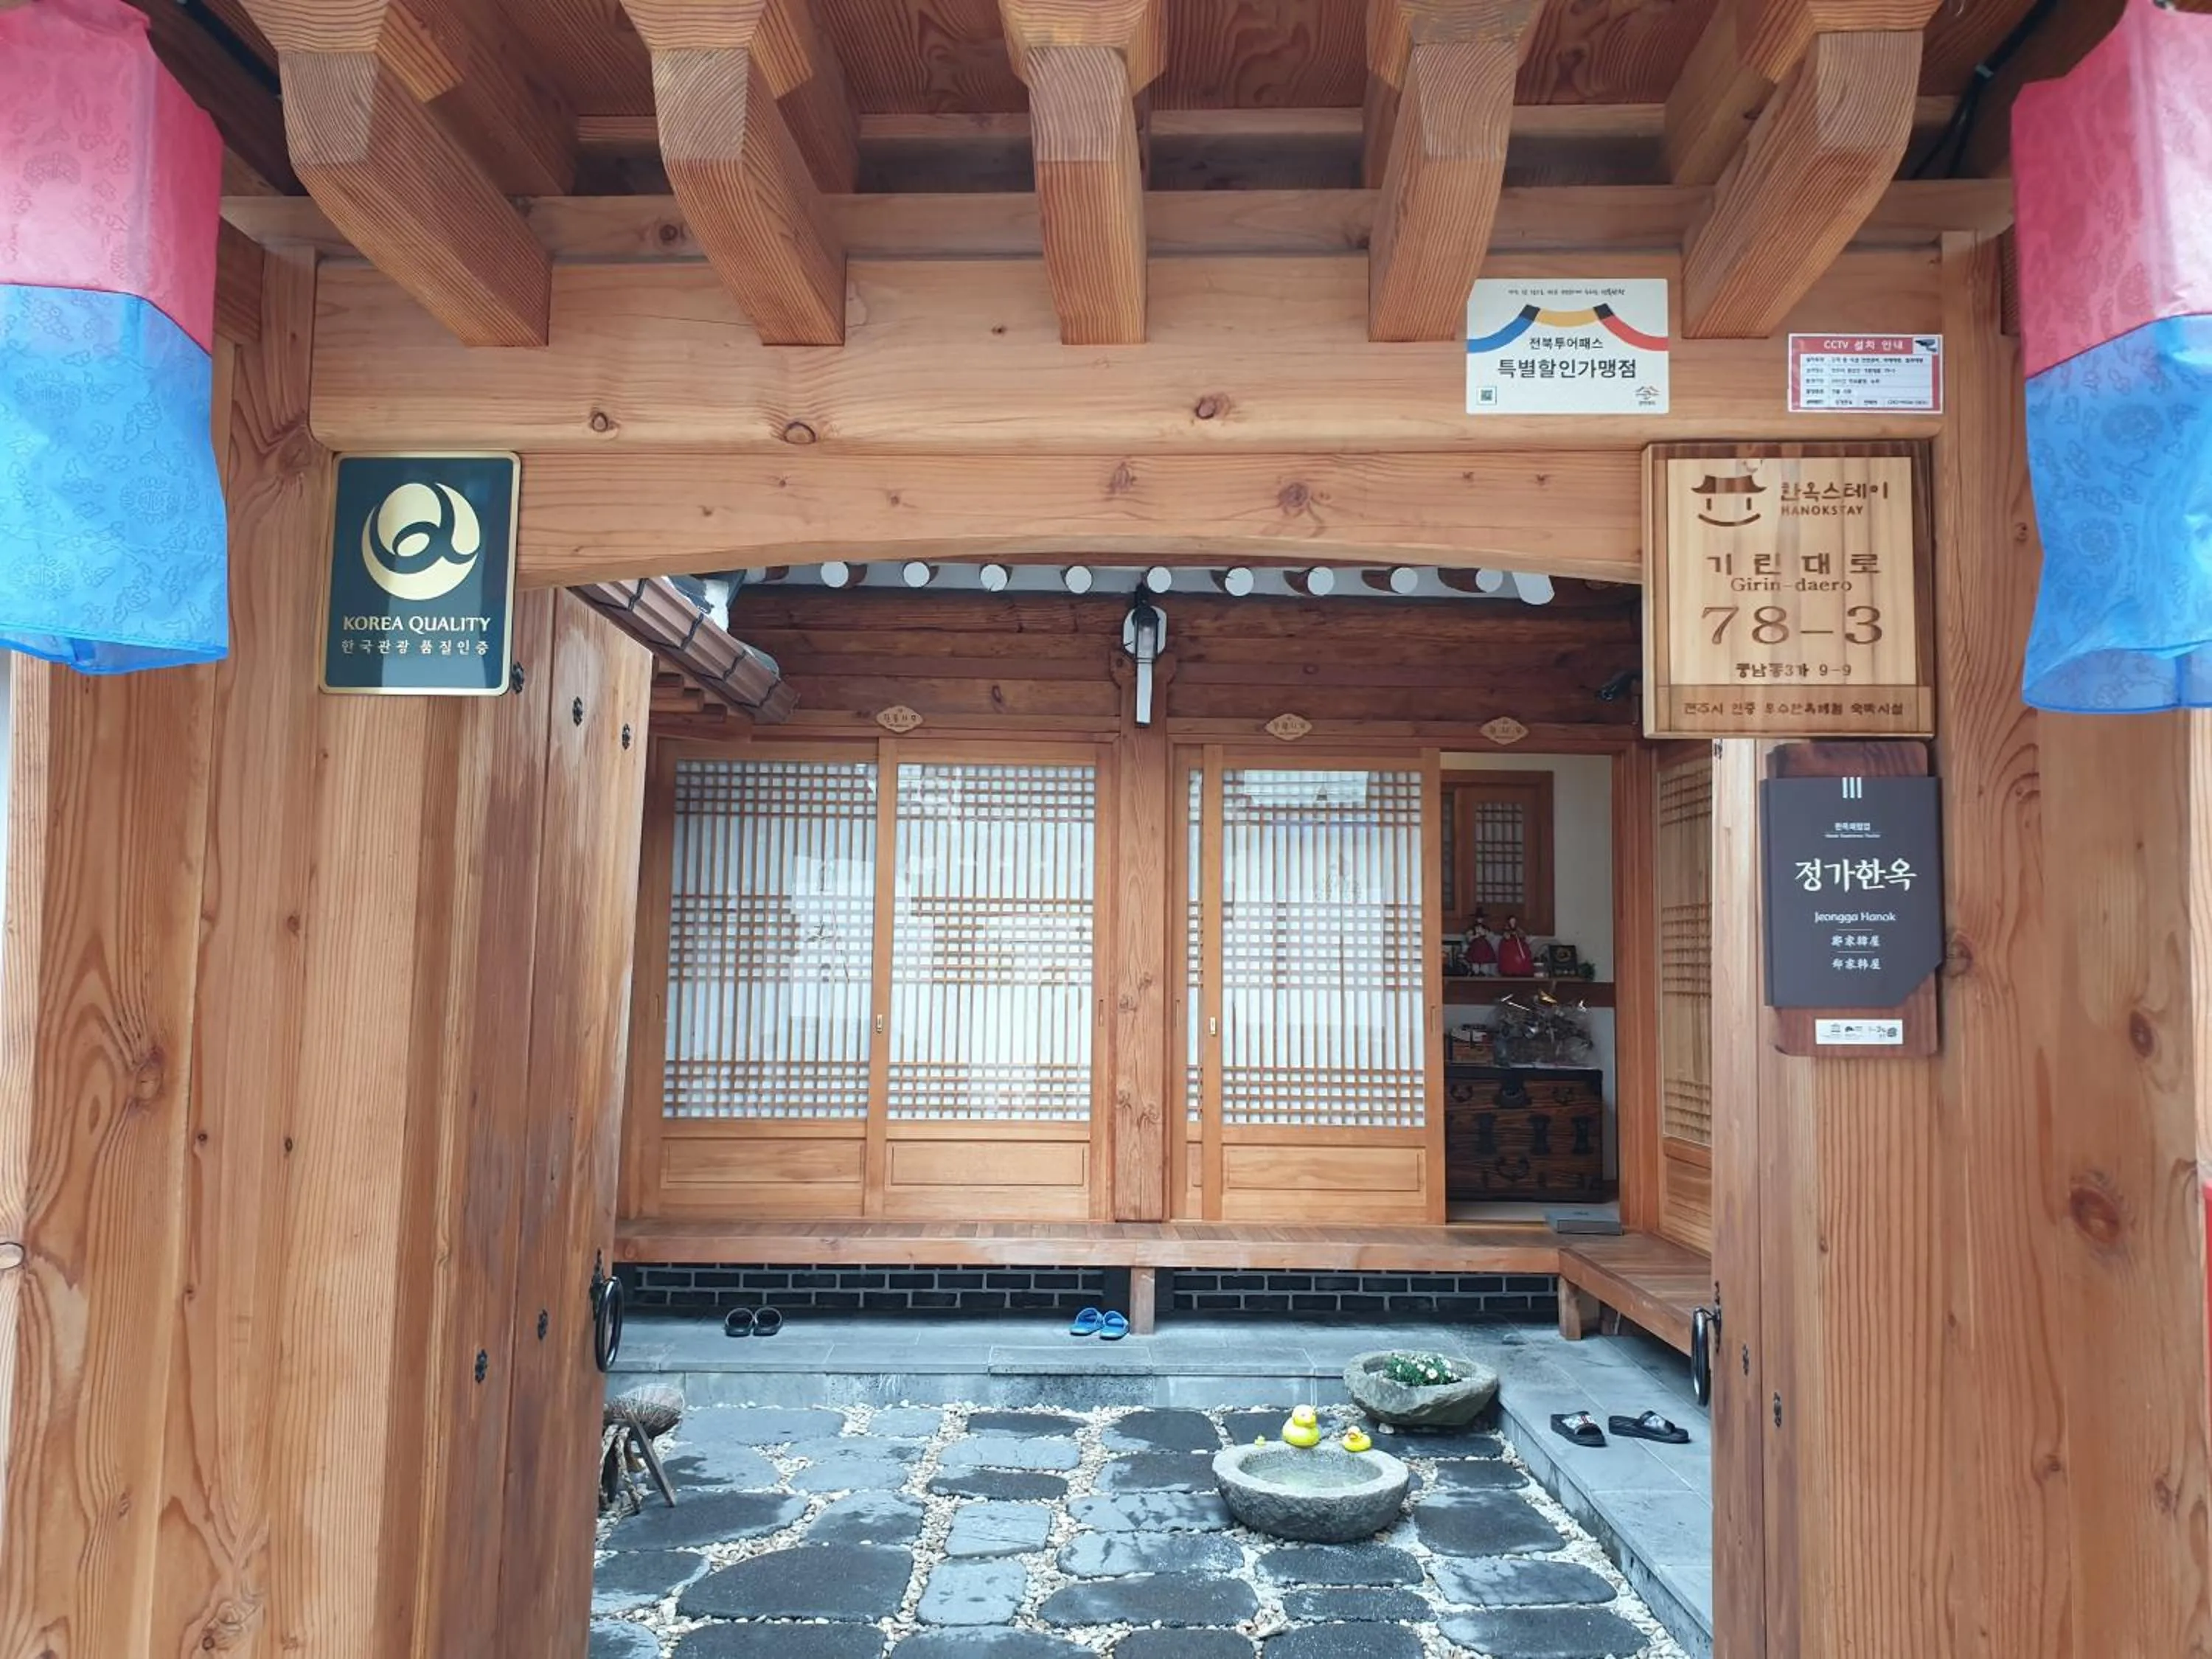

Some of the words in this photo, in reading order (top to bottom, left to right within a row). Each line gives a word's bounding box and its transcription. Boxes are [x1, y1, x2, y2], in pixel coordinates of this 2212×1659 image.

[1528, 337, 1604, 350] 전북투어패스
[1823, 340, 1848, 349] CCTV
[1854, 340, 1875, 351] 설치
[1882, 340, 1904, 351] 안내
[1498, 358, 1638, 379] 특별할인가맹점
[1781, 481, 1888, 502] 한옥스테이
[1781, 505, 1864, 516] HANOKSTAY
[1731, 577, 1853, 592] Girin-daero
[342, 616, 403, 630] KOREA
[408, 616, 491, 635] QUALITY
[1701, 605, 1883, 645] 78-3
[1819, 664, 1852, 677] 9-9
[1795, 858, 1917, 893] 정가한옥
[1815, 911, 1859, 924] Jeongga
[1860, 912, 1896, 922] Hanok
